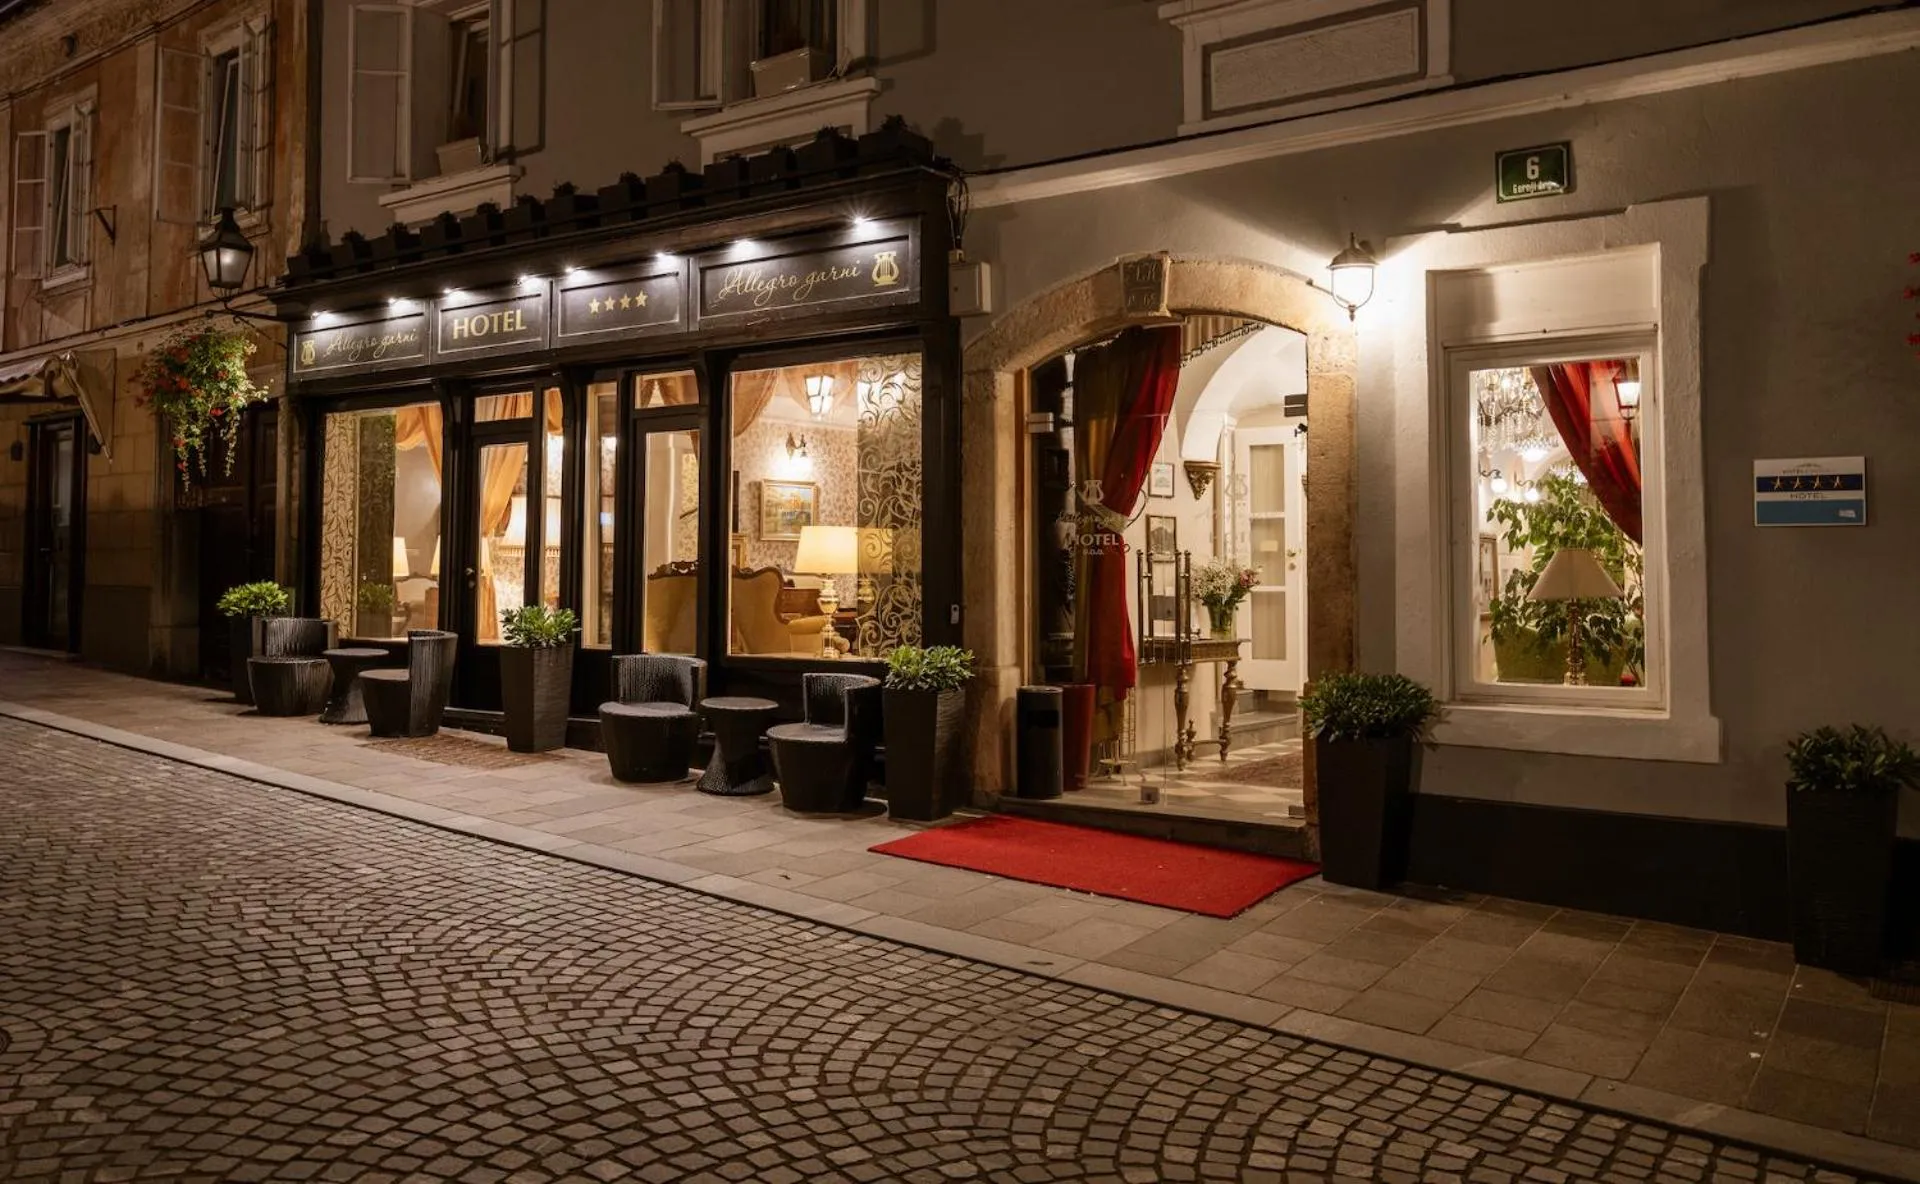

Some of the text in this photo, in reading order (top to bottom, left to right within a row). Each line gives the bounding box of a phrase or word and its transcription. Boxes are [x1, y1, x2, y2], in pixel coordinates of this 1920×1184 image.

[1526, 156, 1540, 180] 6
[714, 260, 861, 307] Allegro garni
[452, 308, 528, 340] HOTEL
[323, 328, 418, 362] Allegro garni
[1069, 533, 1119, 546] HOTEL
